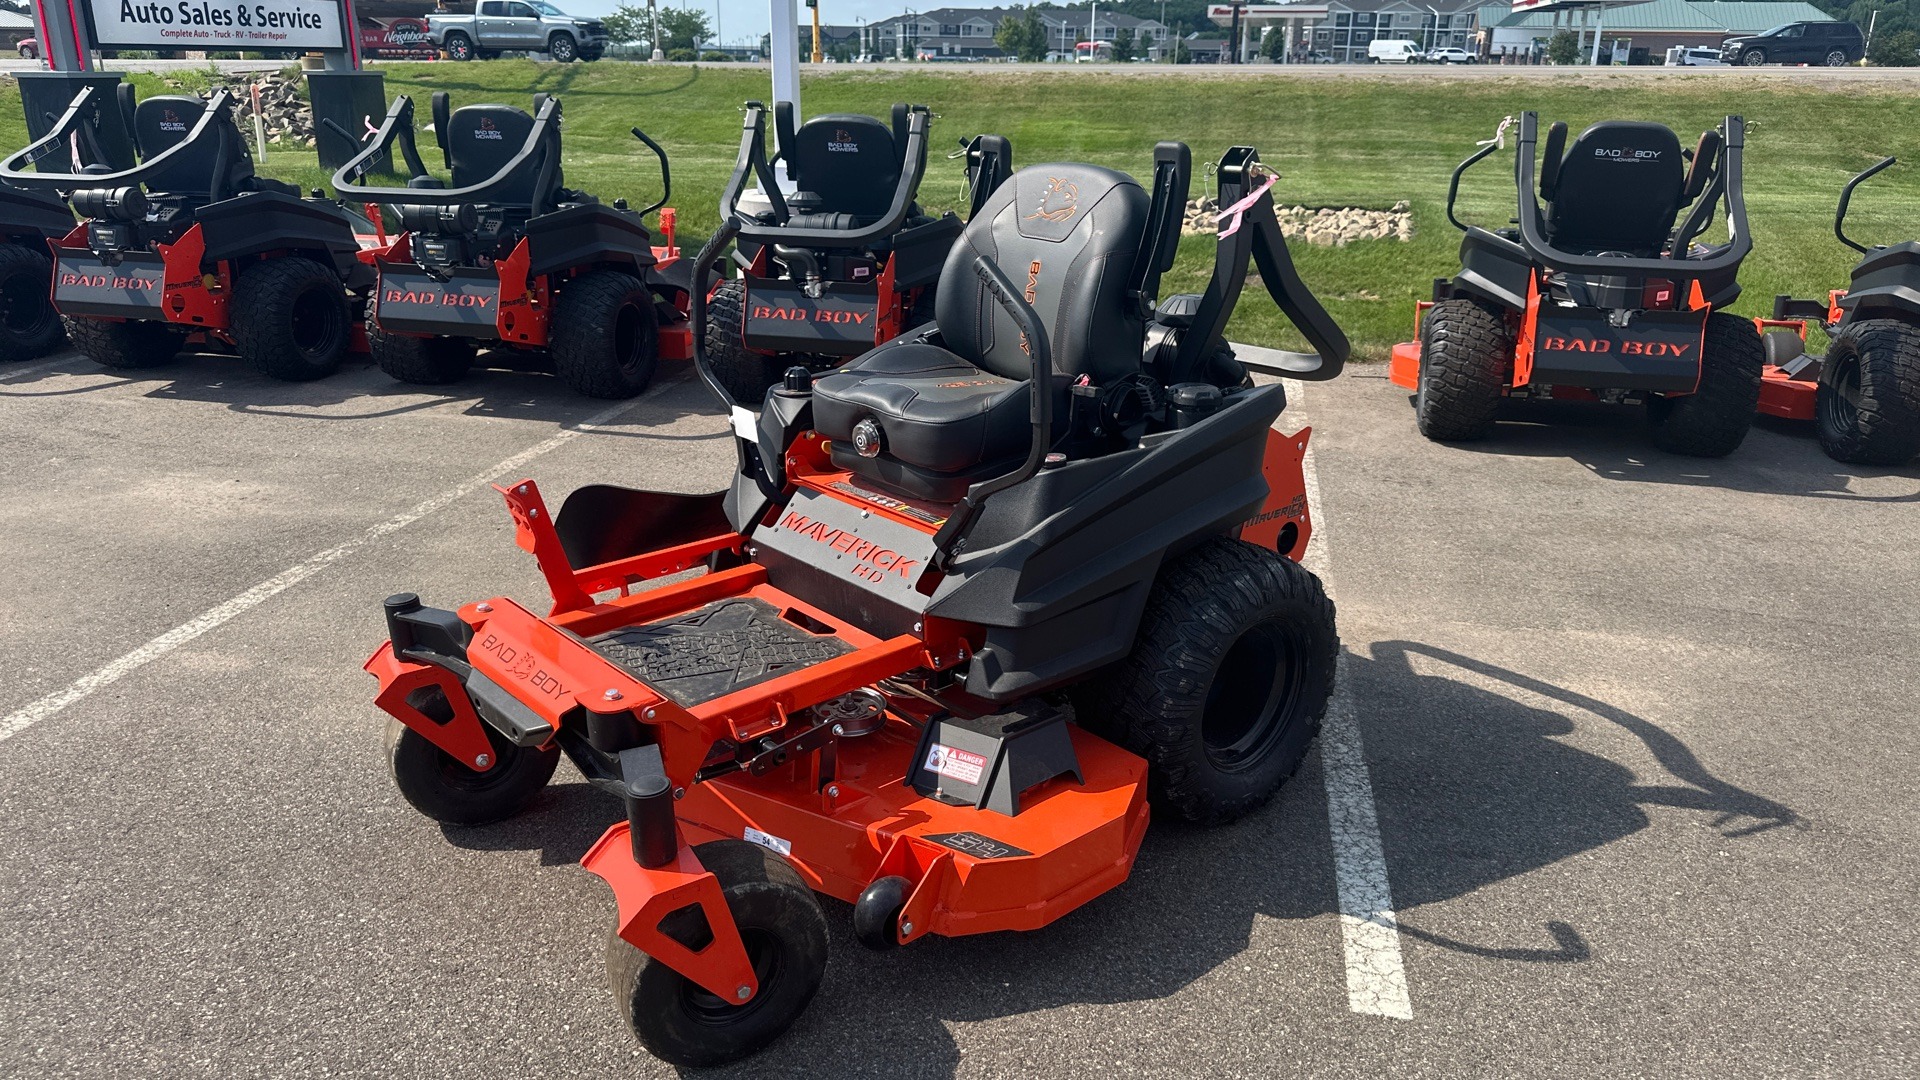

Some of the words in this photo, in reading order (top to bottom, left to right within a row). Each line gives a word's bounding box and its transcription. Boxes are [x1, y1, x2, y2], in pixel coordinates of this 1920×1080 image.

[120, 0, 174, 24] Auto
[178, 2, 233, 26] Sales
[237, 4, 253, 27] &
[255, 5, 322, 29] Service
[160, 29, 193, 39] Complete
[193, 30, 209, 38] Auto
[214, 30, 231, 38] Truck
[248, 31, 268, 40] Trailer
[268, 32, 288, 41] Repair
[1595, 148, 1621, 157] BAD
[1634, 150, 1662, 158] BOY
[61, 273, 107, 288] BAD
[111, 276, 159, 292] BOY
[1024, 260, 1042, 305] BAD
[386, 290, 435, 304] BAD
[442, 293, 493, 308] BOY
[753, 305, 808, 321] BAD
[814, 309, 870, 325] BOY
[1543, 336, 1611, 353] BAD
[1620, 340, 1692, 357] BOY
[780, 511, 920, 580] MAVERICK
[851, 563, 885, 584] HD
[481, 634, 517, 663] BAD
[530, 669, 571, 700] BOY
[958, 752, 984, 766] DANGER
[762, 836, 771, 846] 54
[943, 833, 1009, 859] 54
